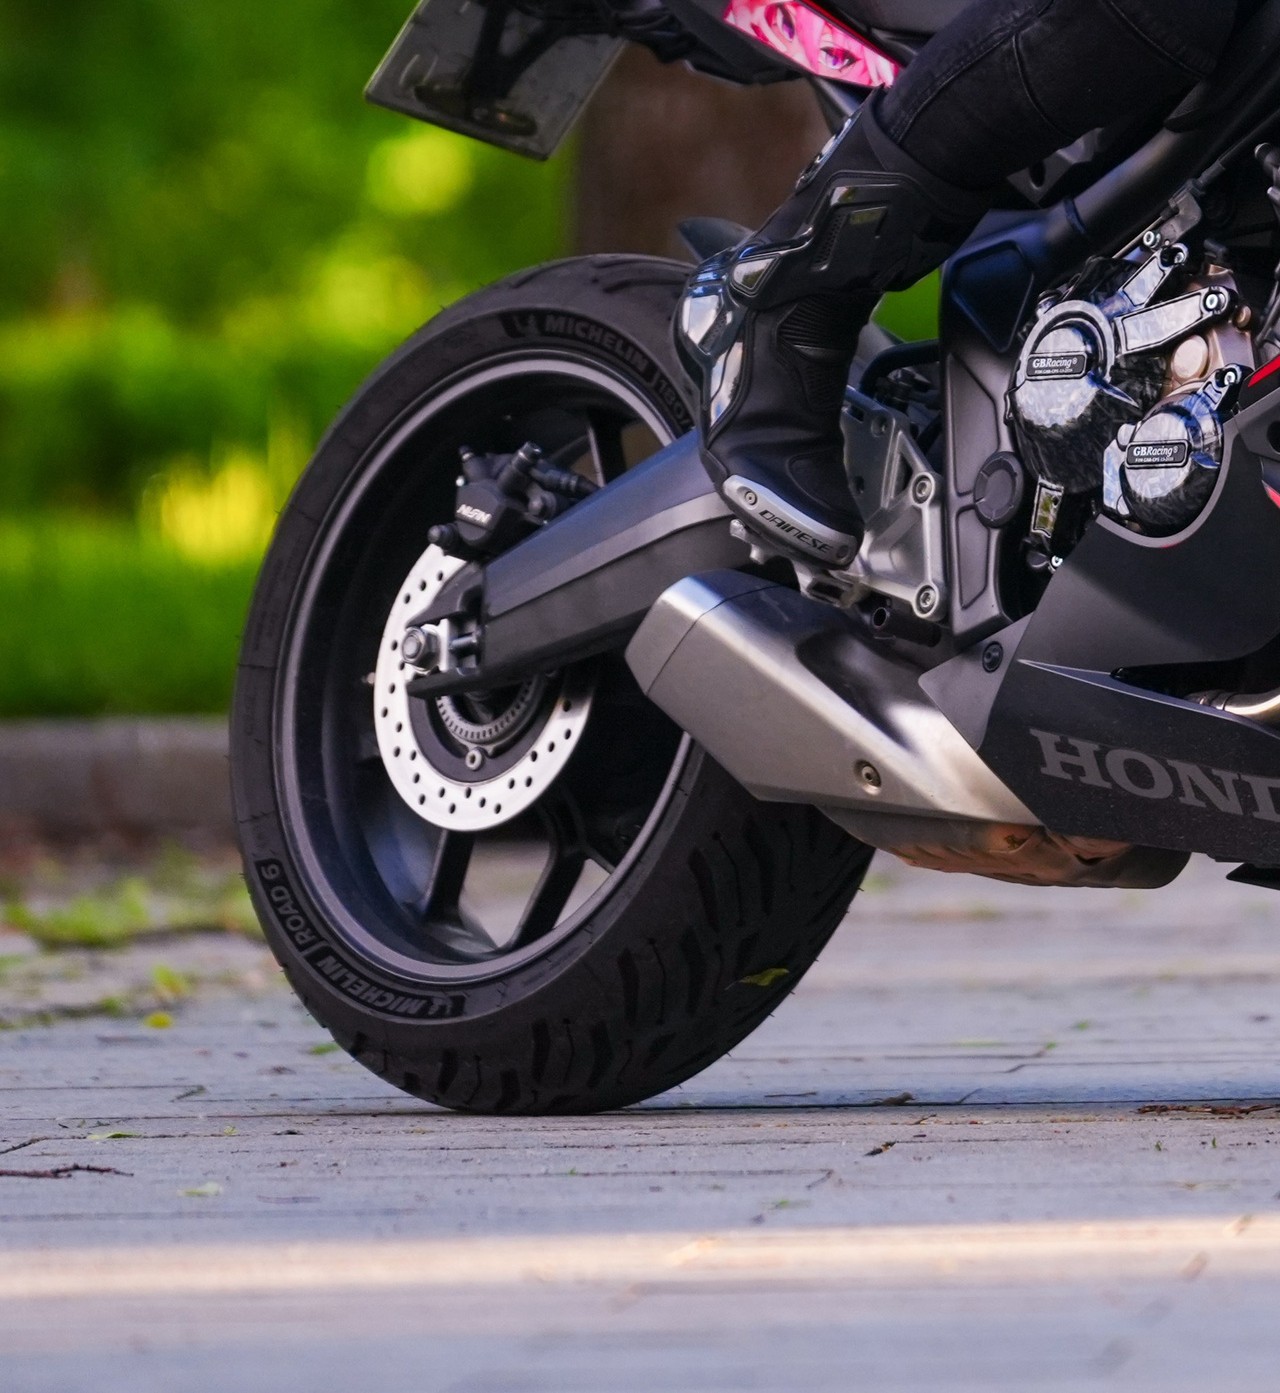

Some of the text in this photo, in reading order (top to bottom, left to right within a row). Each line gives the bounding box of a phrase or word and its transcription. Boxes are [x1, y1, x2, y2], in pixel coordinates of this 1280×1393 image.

[544, 314, 648, 373] MICHELIN
[758, 509, 833, 554] DAINESE
[270, 887, 316, 949] ROAD
[315, 955, 428, 1016] MICHELIN
